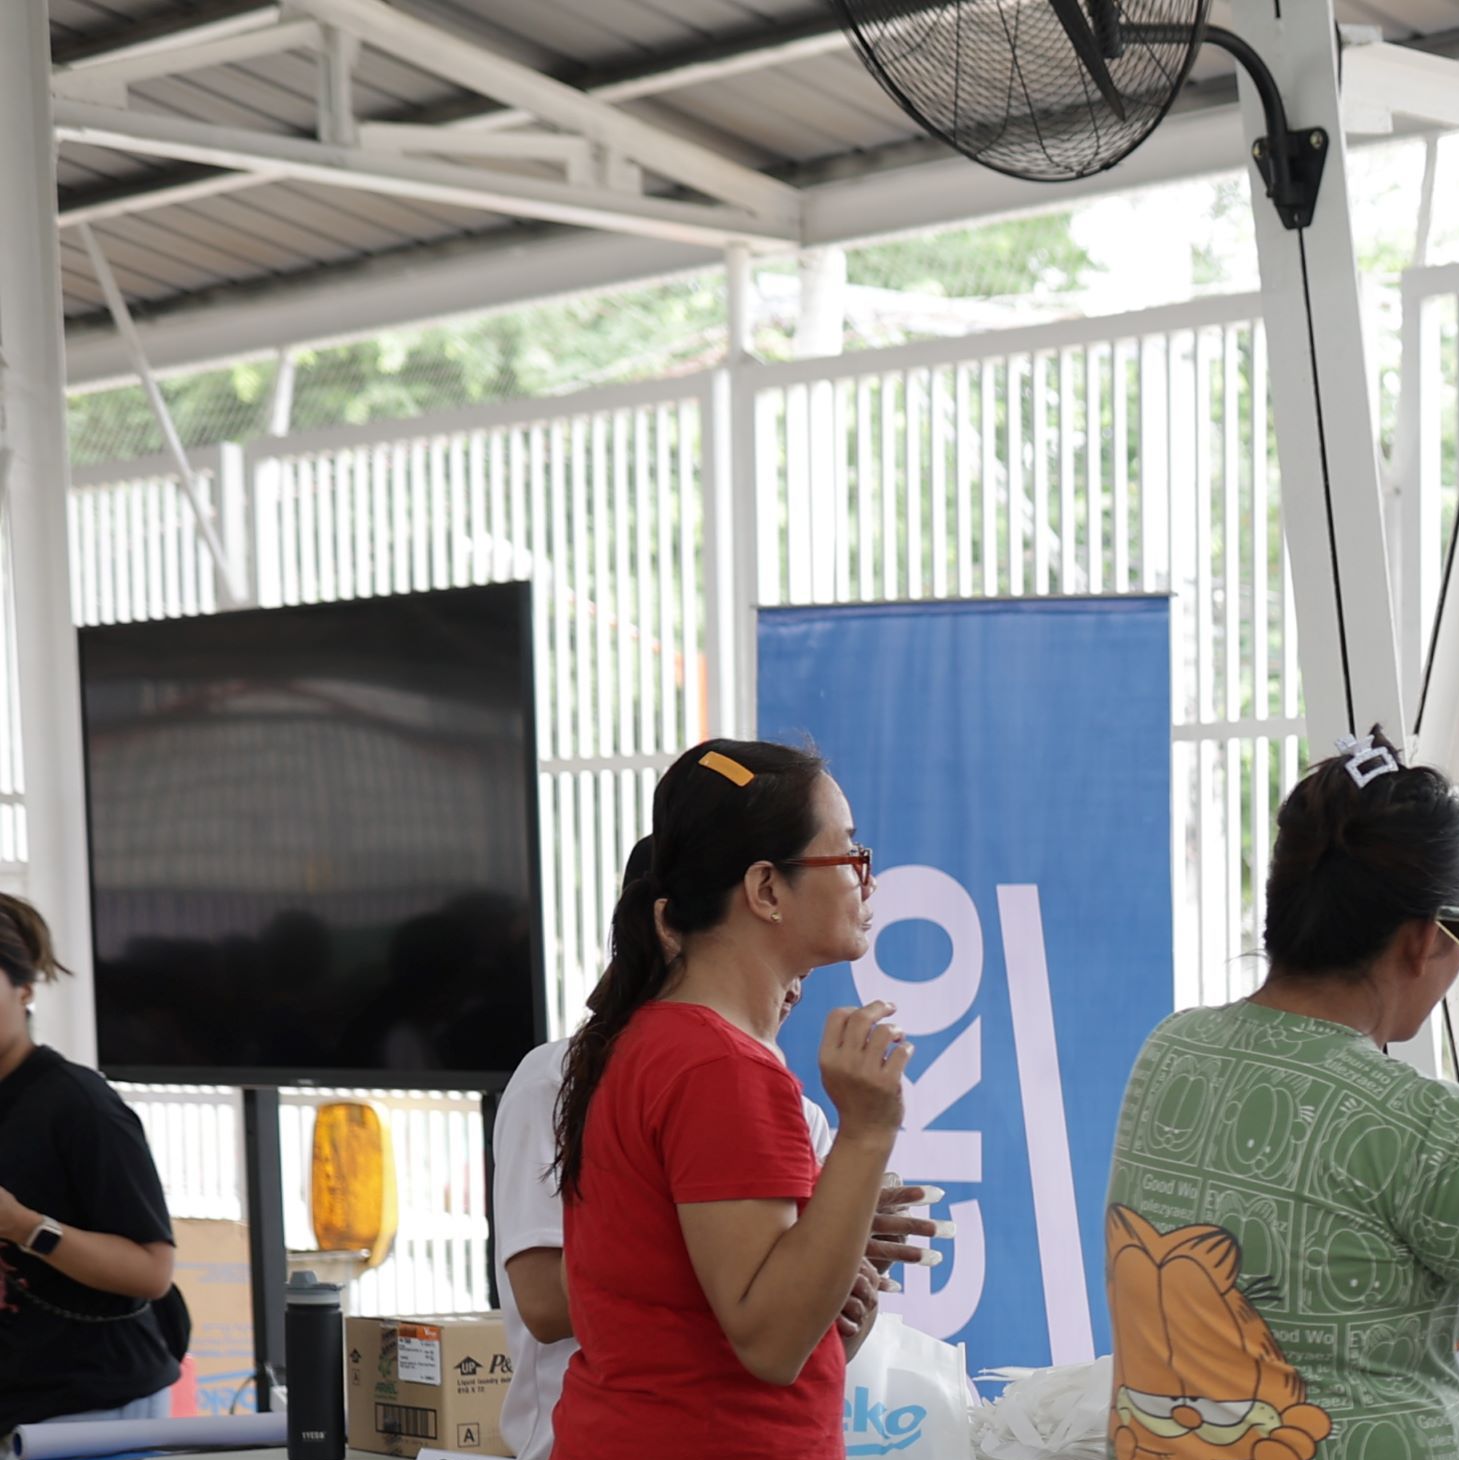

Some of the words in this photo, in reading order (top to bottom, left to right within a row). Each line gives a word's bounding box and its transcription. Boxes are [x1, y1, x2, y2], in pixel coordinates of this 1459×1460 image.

[1272, 1329, 1300, 1344] ood
[489, 1353, 514, 1375] P&
[463, 1427, 475, 1443] A
